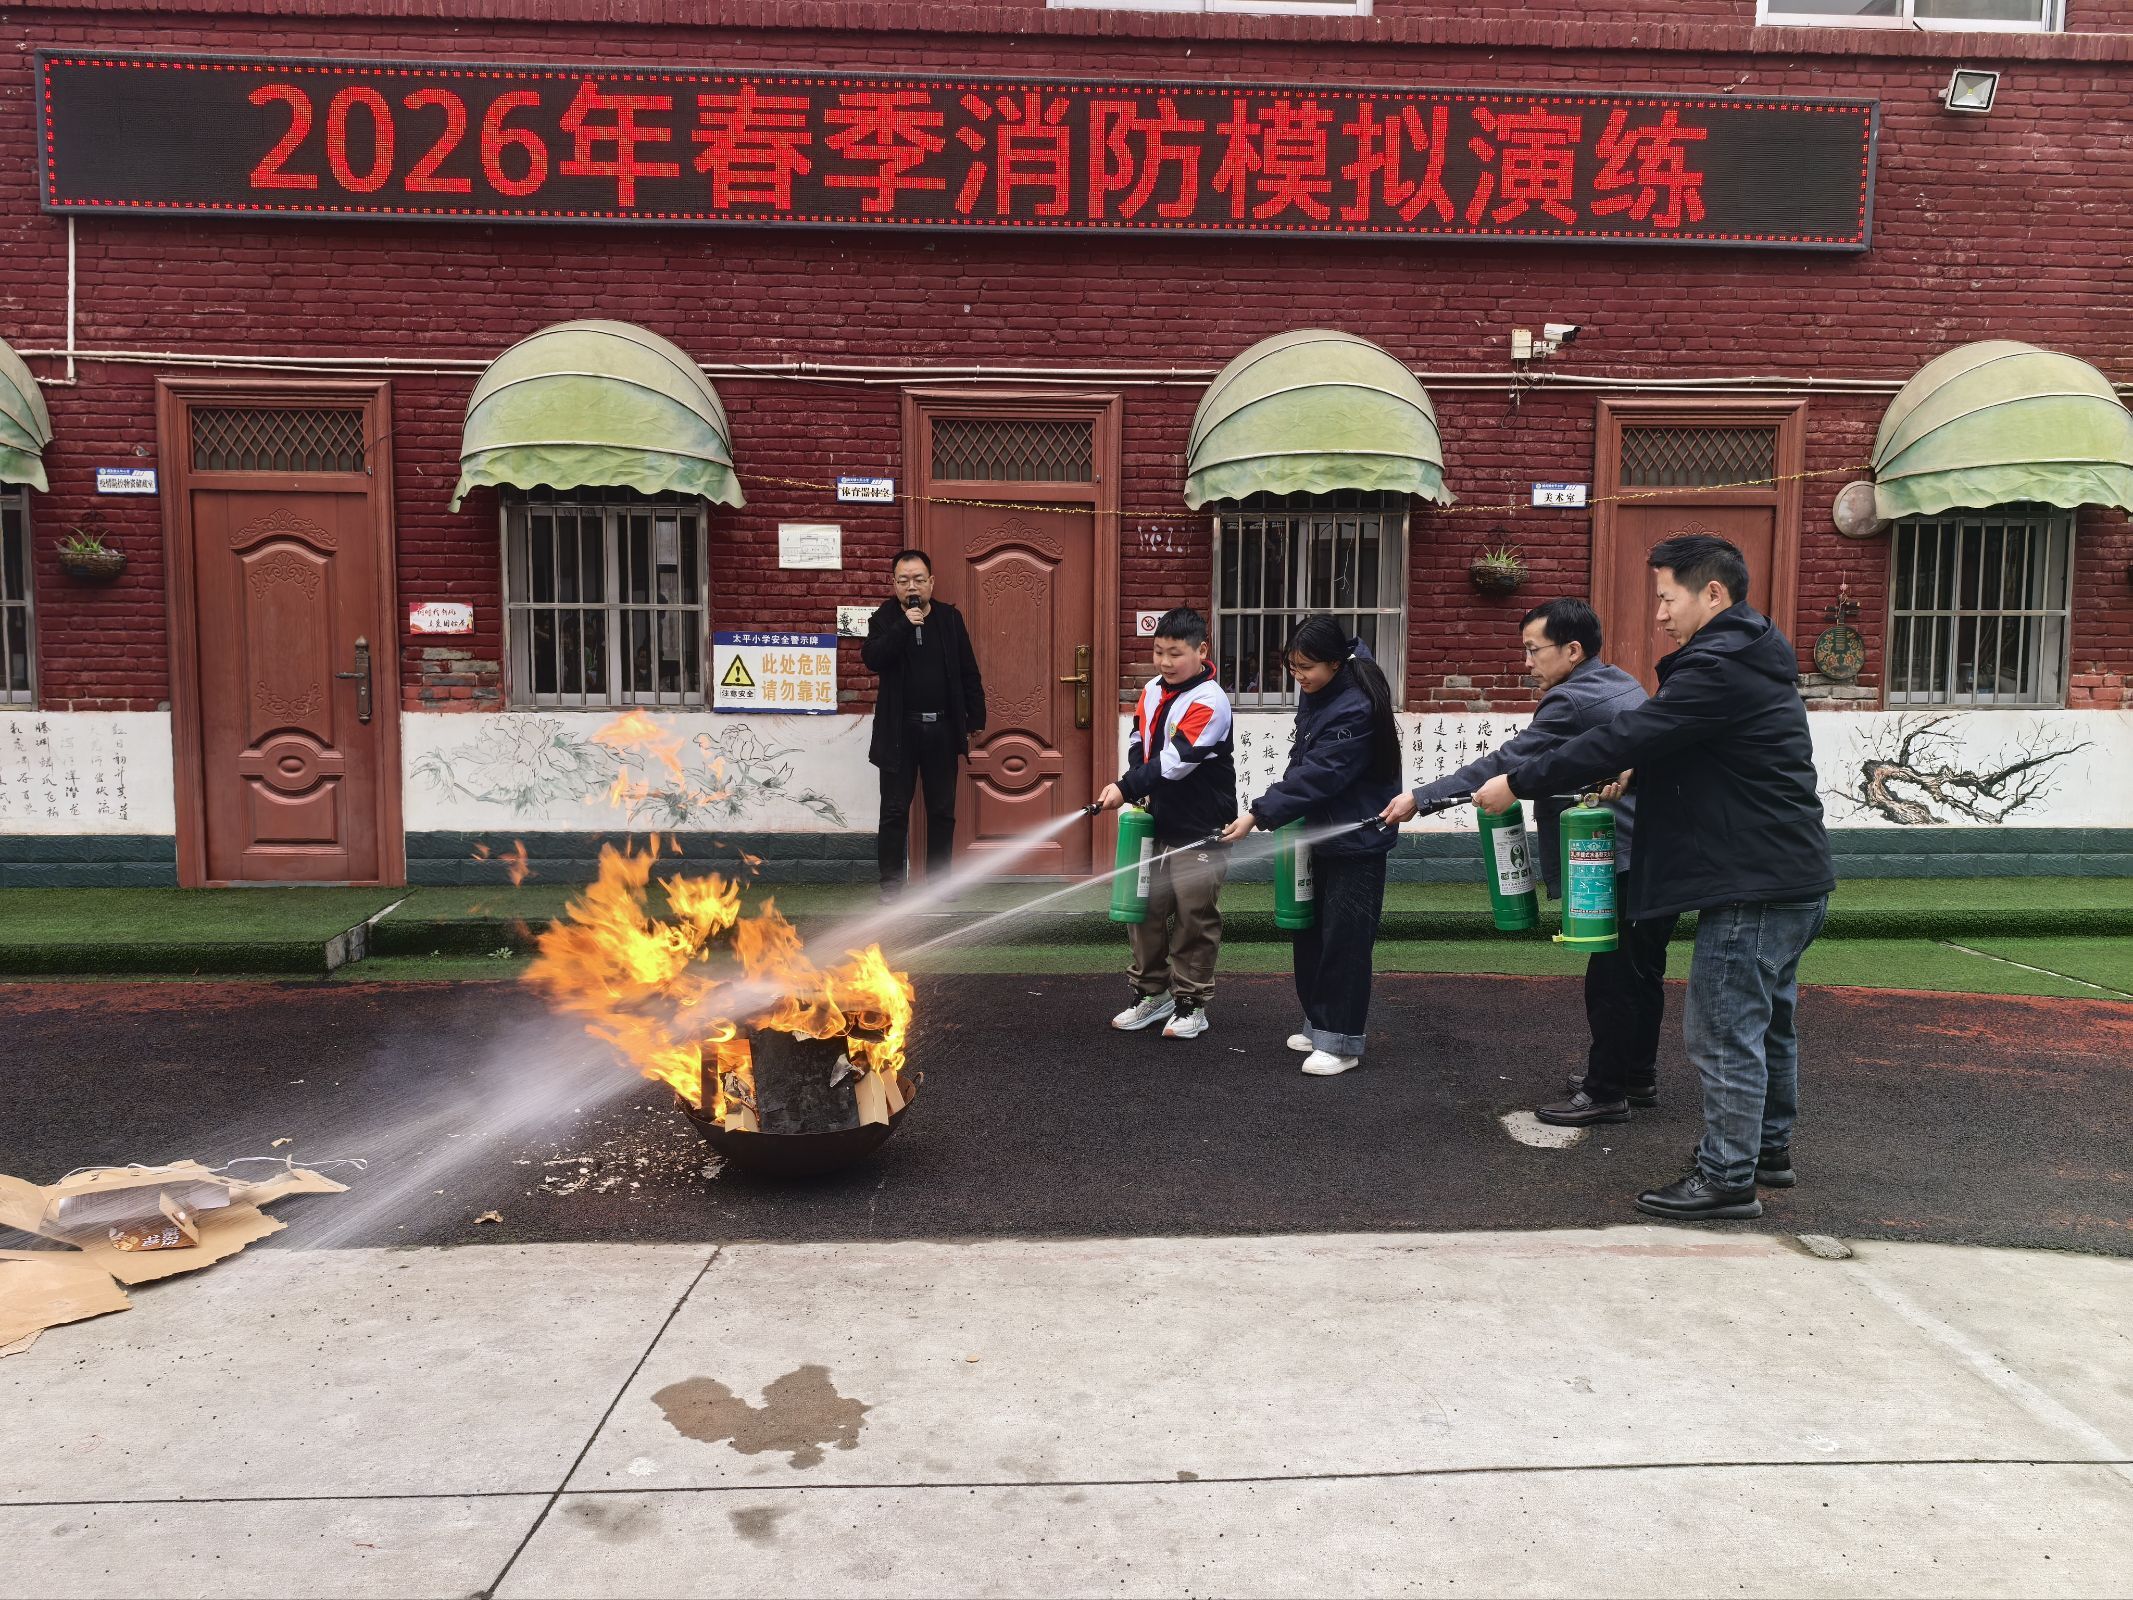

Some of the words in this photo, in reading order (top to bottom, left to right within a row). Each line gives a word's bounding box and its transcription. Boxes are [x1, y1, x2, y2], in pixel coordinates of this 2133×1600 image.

[247, 81, 1708, 228] 2026年春季消防模拟演练
[841, 486, 890, 498] 体育器材室
[1544, 492, 1575, 504] 美术室
[732, 634, 819, 645] 太平小学安全警示牌
[762, 653, 832, 676] 此处危险
[721, 690, 754, 698] 注意安全
[762, 680, 832, 702] 请勿靠近
